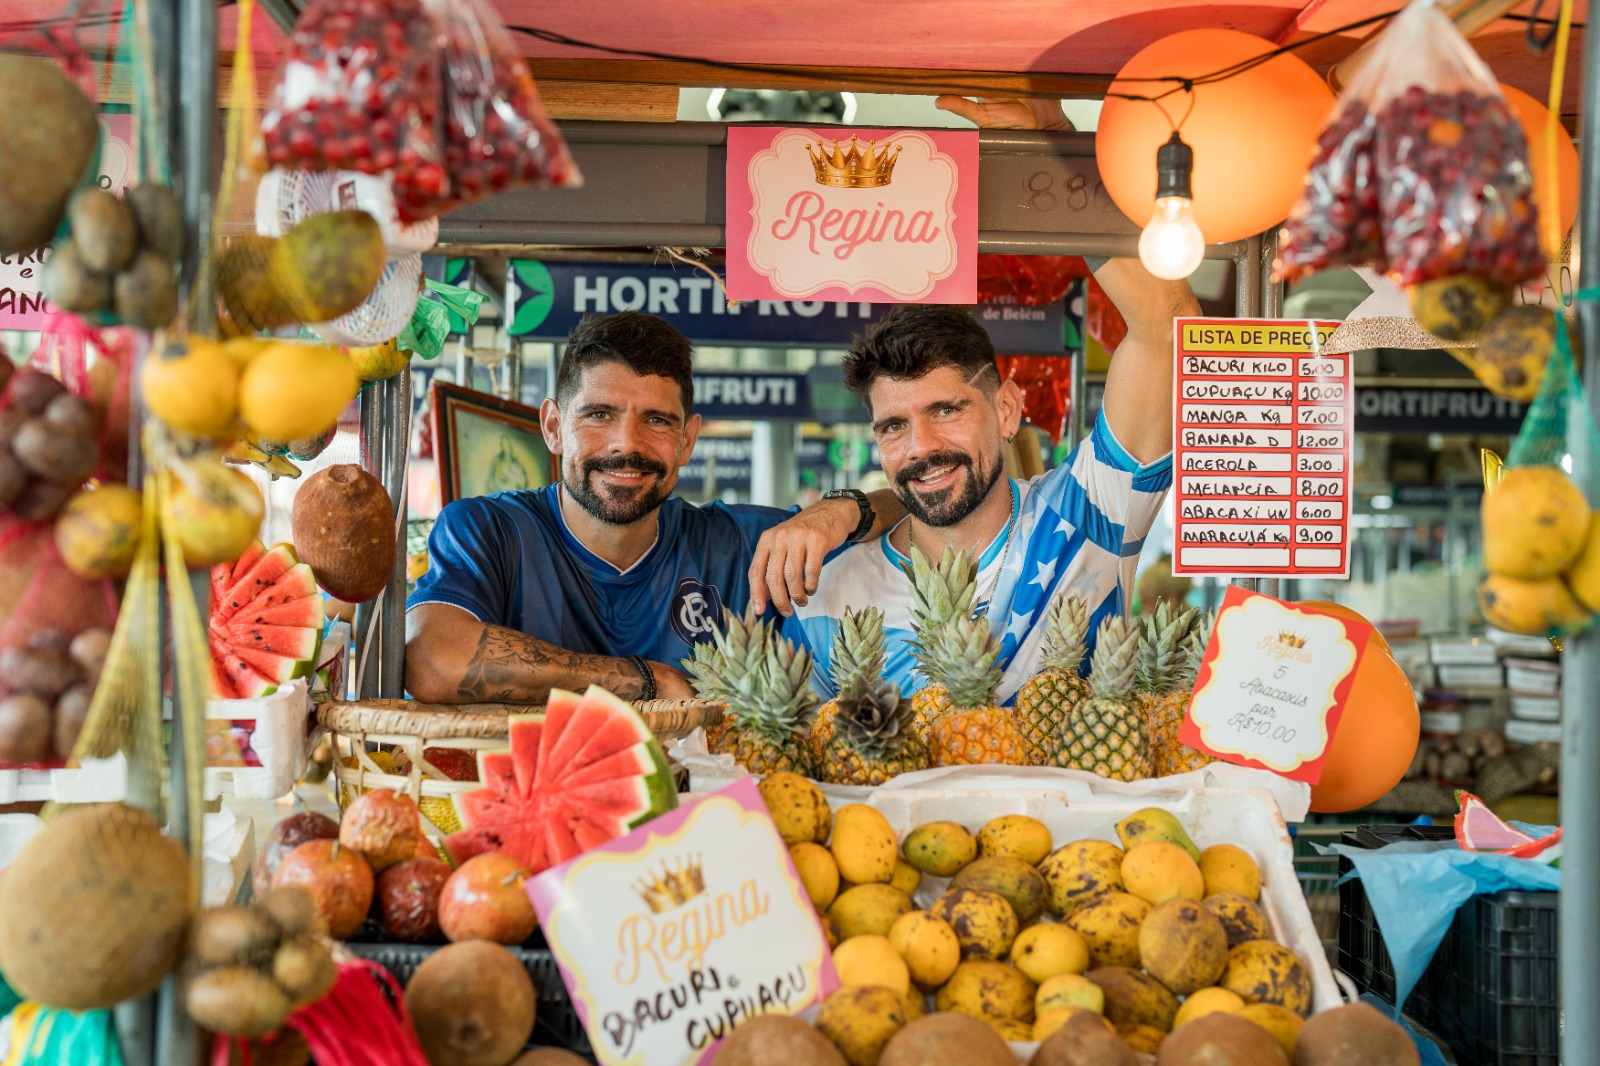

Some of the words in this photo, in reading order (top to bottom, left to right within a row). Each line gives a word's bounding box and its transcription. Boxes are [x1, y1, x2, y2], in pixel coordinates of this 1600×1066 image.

[771, 190, 941, 261] Regina
[1189, 330, 1235, 344] LISTA
[1240, 331, 1263, 345] DE
[1186, 356, 1245, 373] BACURI
[1252, 361, 1287, 373] KILO
[1186, 385, 1267, 400] CUPUAÇU
[1272, 386, 1293, 405] Kg
[1187, 410, 1248, 424] MANGA
[1261, 409, 1281, 426] Kg
[1185, 431, 1257, 446] BANANA
[1268, 436, 1279, 447] D
[1185, 457, 1258, 471] ACEROLA
[1183, 528, 1268, 546] MARACUJÁ
[1257, 635, 1312, 663] Regina
[1273, 665, 1289, 679] 5
[1239, 677, 1309, 708] Abacaxis
[1247, 702, 1278, 719] por
[613, 878, 770, 985] Regina
[603, 967, 721, 1059] BACURI
